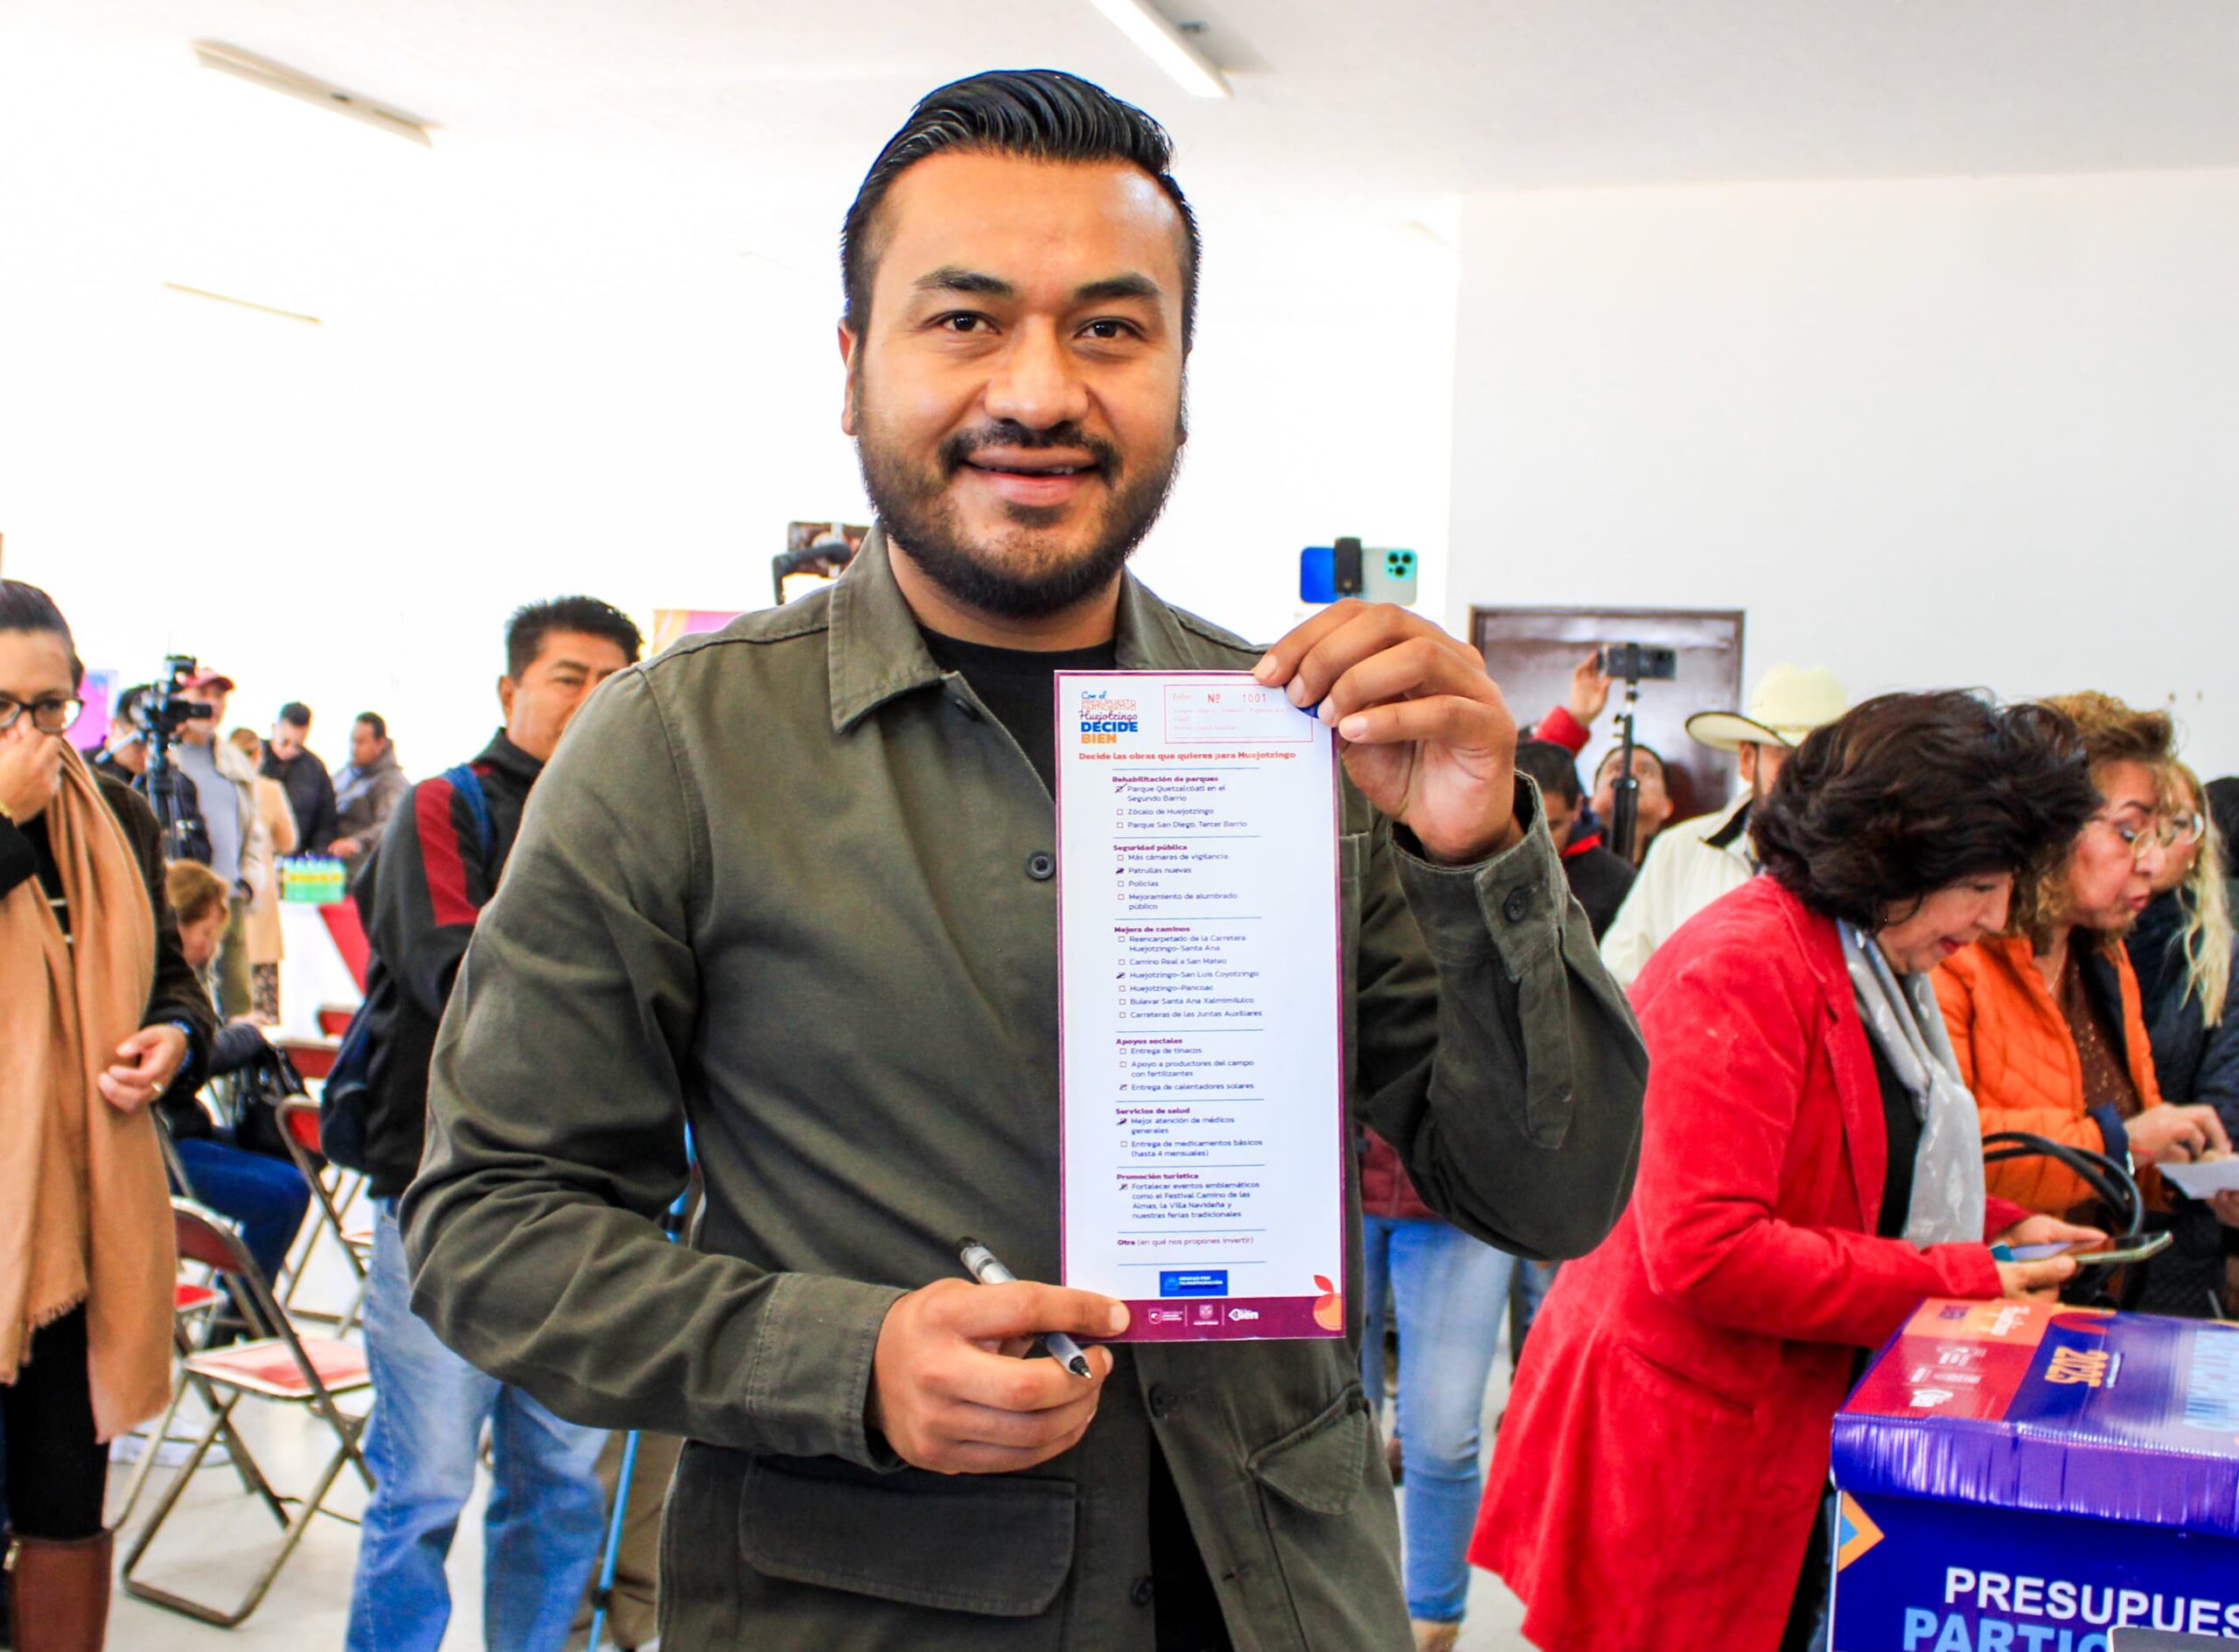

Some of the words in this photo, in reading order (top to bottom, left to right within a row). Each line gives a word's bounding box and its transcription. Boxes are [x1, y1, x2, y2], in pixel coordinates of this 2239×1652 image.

[1242, 694, 1266, 703] 1001
[1078, 709, 1138, 723] Huejotzingo
[1081, 721, 1139, 732] DECIDE
[1081, 734, 1117, 743] BIEN
[1078, 752, 1112, 760] Decide
[1157, 754, 1175, 762] que
[1177, 752, 1213, 762] quieres
[1214, 753, 1236, 762] para
[1238, 751, 1296, 761] Huejotzingo
[1127, 785, 1155, 794] Parque
[1127, 795, 1162, 803] Segundo
[1127, 821, 1155, 830] Parque
[1113, 844, 1155, 852] Seguridad
[1156, 844, 1188, 852] pública
[1128, 893, 1183, 902] Mejoramiento
[1128, 903, 1158, 912] público
[1114, 926, 1143, 935] Mejora
[1129, 935, 1188, 944] Reencarpetado
[1130, 1047, 1161, 1056] Entrega
[1131, 1061, 1157, 1069] Apoyo
[1131, 1118, 1153, 1126] Mejor
[1131, 1127, 1169, 1136] generales
[1131, 1140, 1161, 1149] Entrega
[1152, 1238, 1167, 1247] qué
